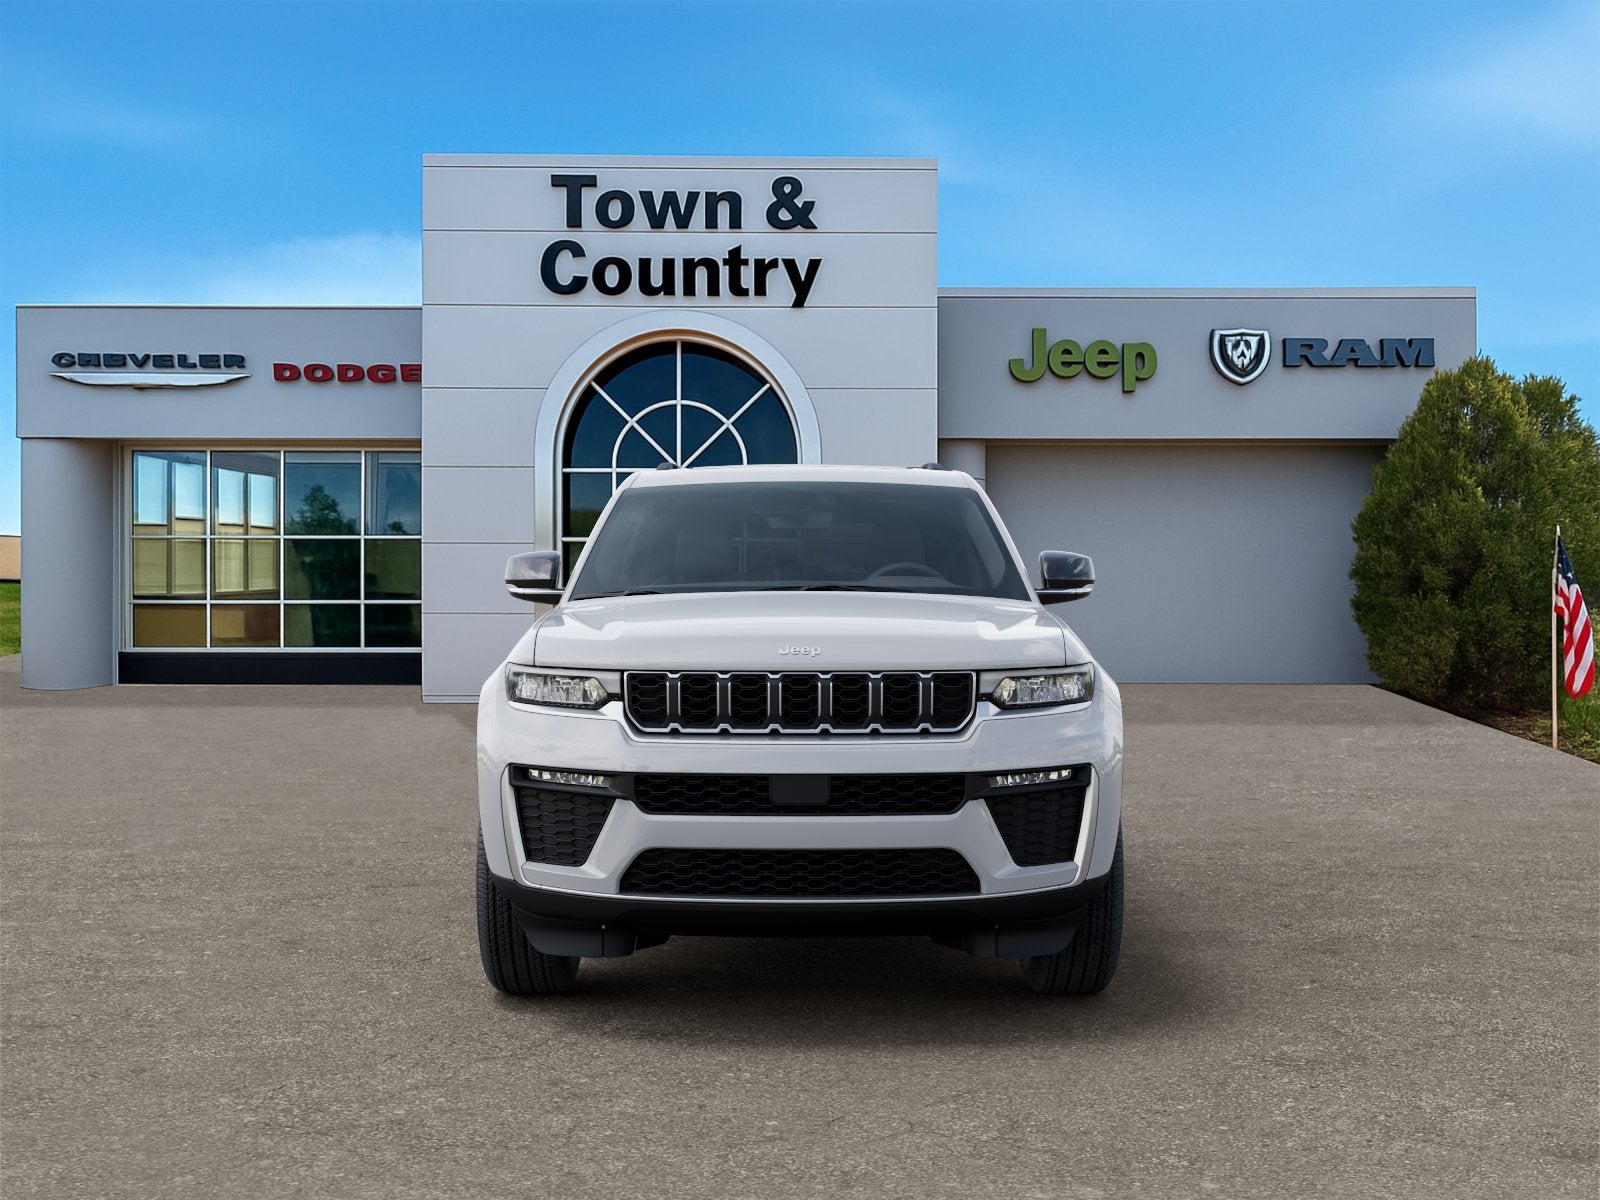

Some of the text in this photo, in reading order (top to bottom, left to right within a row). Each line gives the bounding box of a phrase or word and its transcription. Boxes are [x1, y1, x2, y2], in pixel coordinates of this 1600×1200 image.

[551, 174, 817, 230] Town &
[540, 239, 822, 308] Country
[273, 363, 422, 383] DODGE
[1009, 328, 1158, 393] Jeep
[1282, 337, 1436, 368] RAM
[778, 643, 821, 657] Jeep
